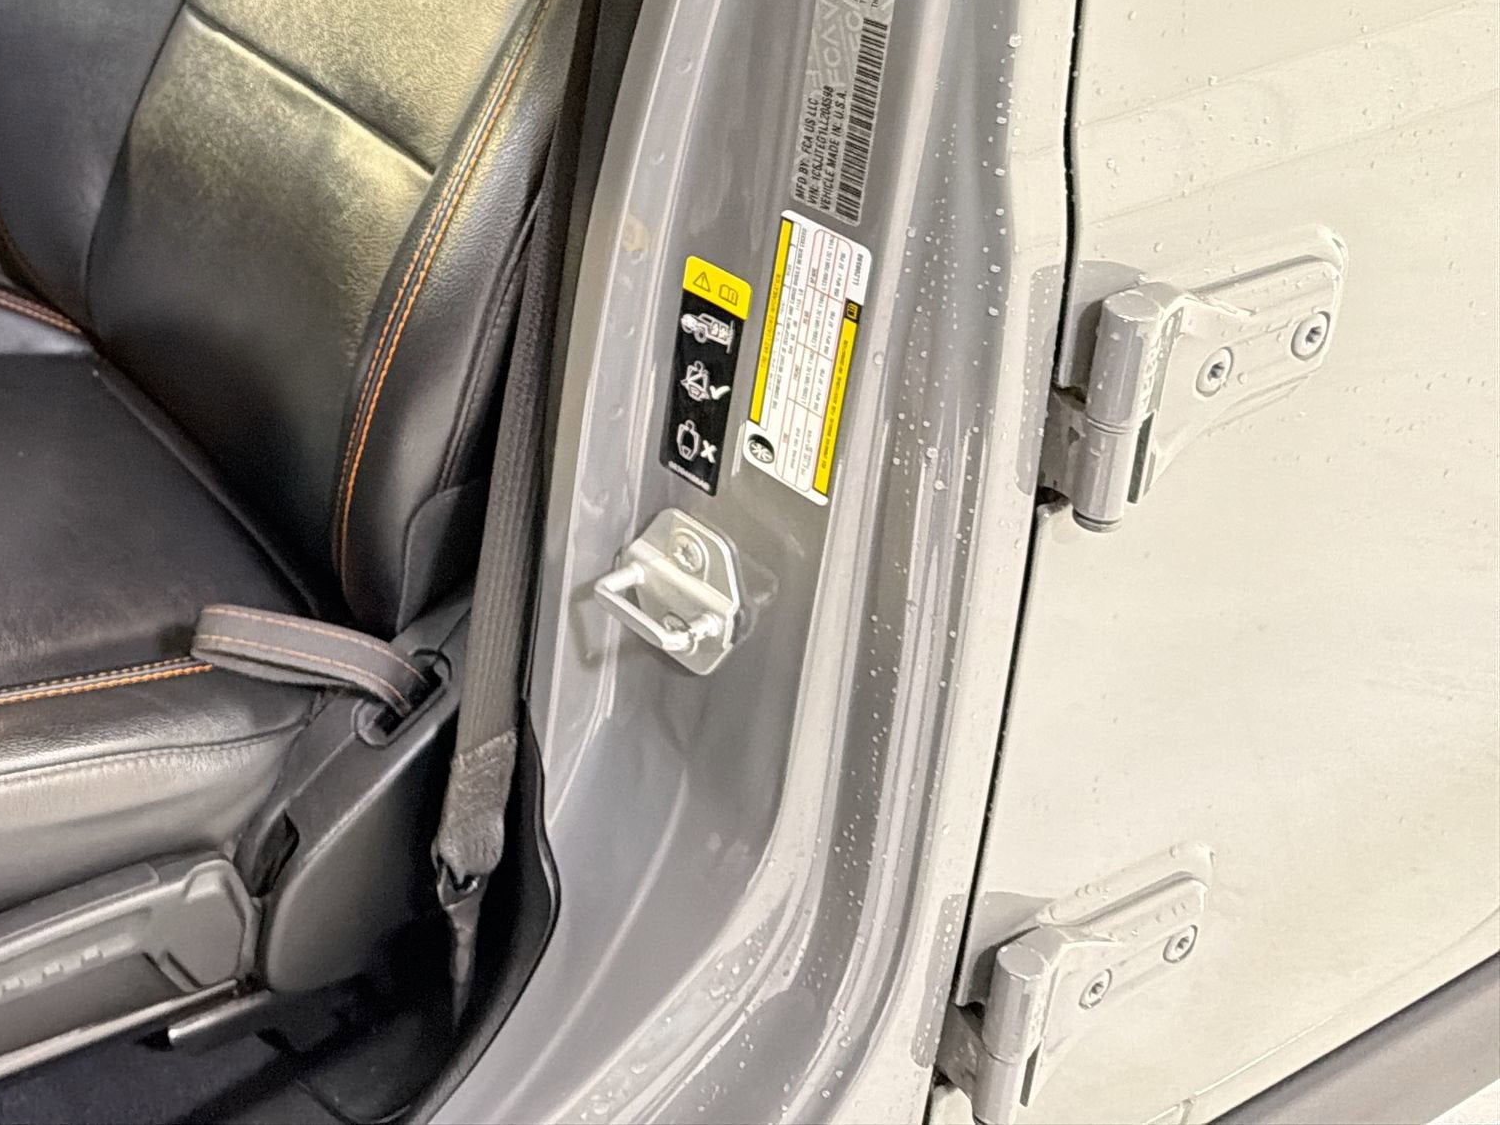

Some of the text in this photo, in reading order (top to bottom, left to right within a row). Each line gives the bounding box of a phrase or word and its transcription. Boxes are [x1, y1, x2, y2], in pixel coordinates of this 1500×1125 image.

[805, 96, 818, 117] LLC
[803, 116, 815, 133] US
[800, 133, 813, 155] FCA
[825, 137, 840, 169] MADE
[794, 174, 808, 200] MFD
[819, 168, 835, 211] VEHICLE
